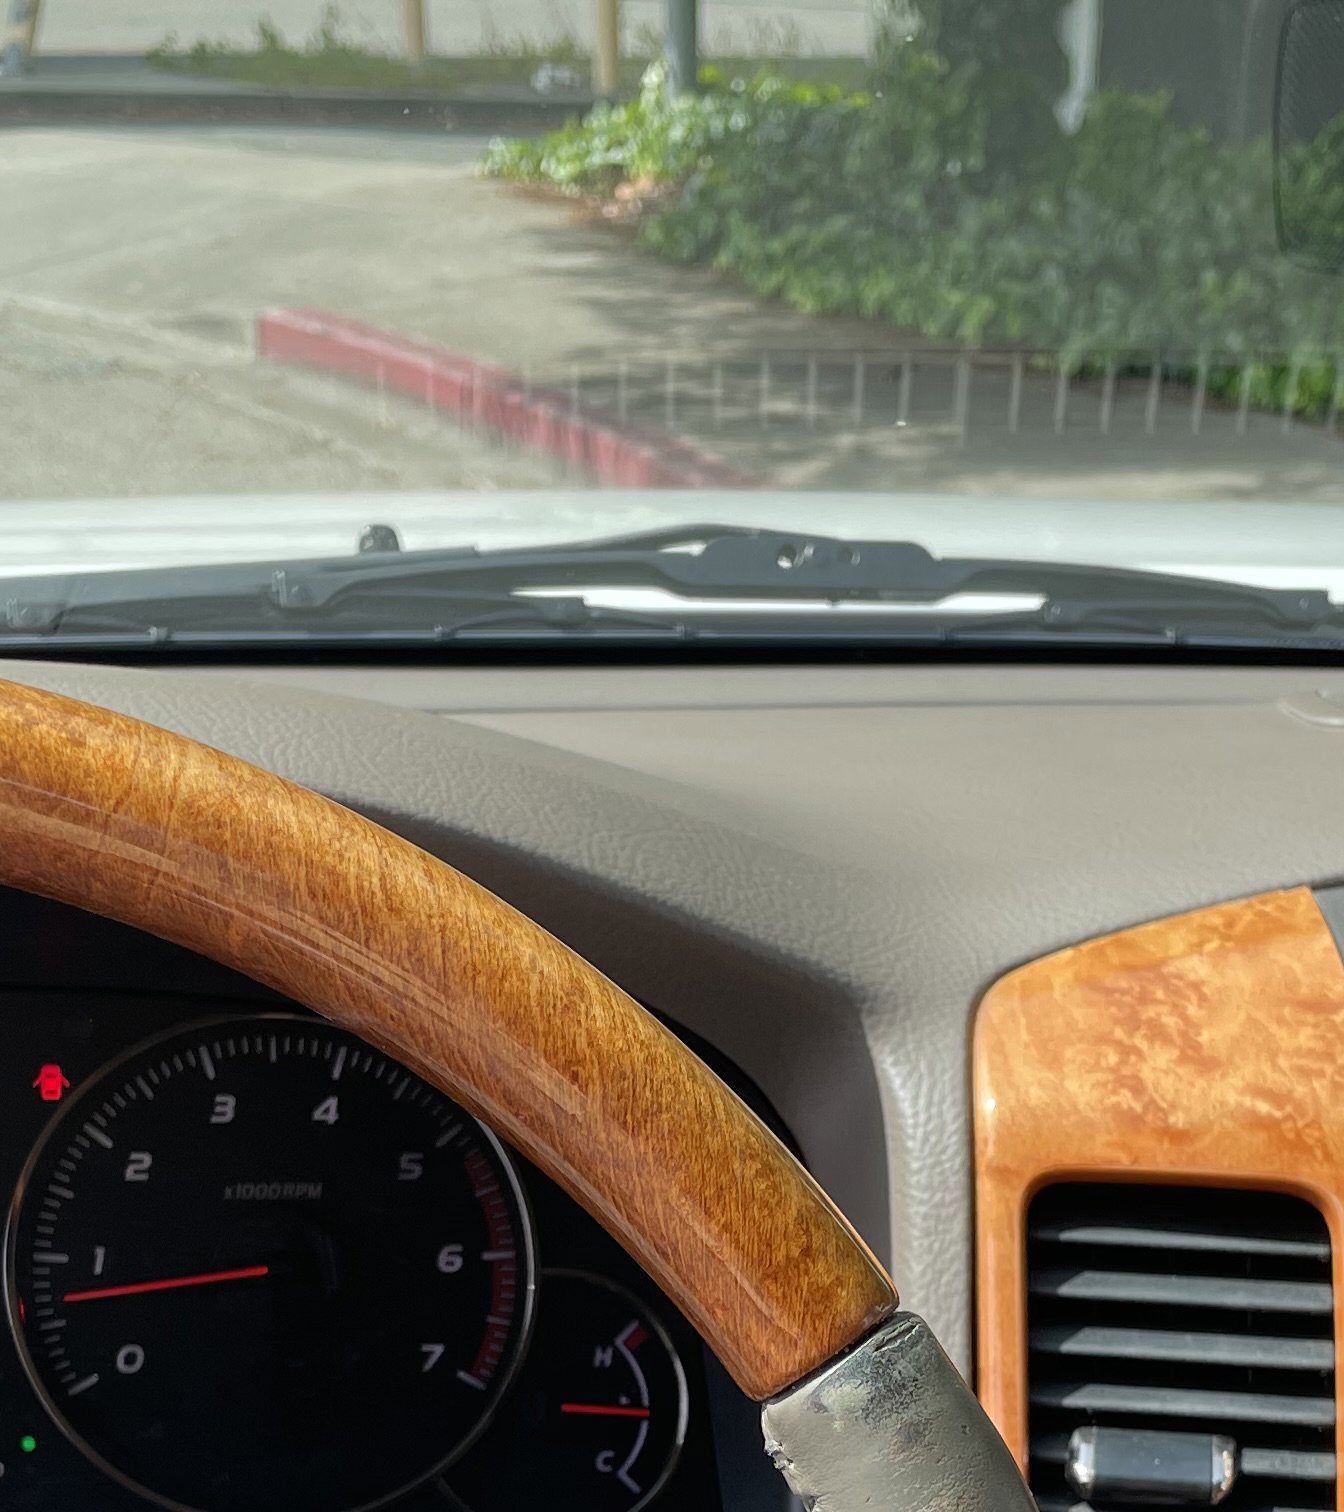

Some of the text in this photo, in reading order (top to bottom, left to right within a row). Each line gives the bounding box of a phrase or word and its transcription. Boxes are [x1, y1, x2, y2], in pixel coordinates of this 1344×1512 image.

[209, 1093, 236, 1124] 3
[311, 1094, 340, 1125] 4
[124, 1151, 153, 1182] 2
[398, 1152, 425, 1181] 5
[92, 1245, 107, 1277] 1
[435, 1243, 465, 1275] 6
[115, 1343, 145, 1375] 0
[419, 1342, 446, 1373] 7
[592, 1346, 614, 1368] H
[594, 1450, 616, 1474] C
